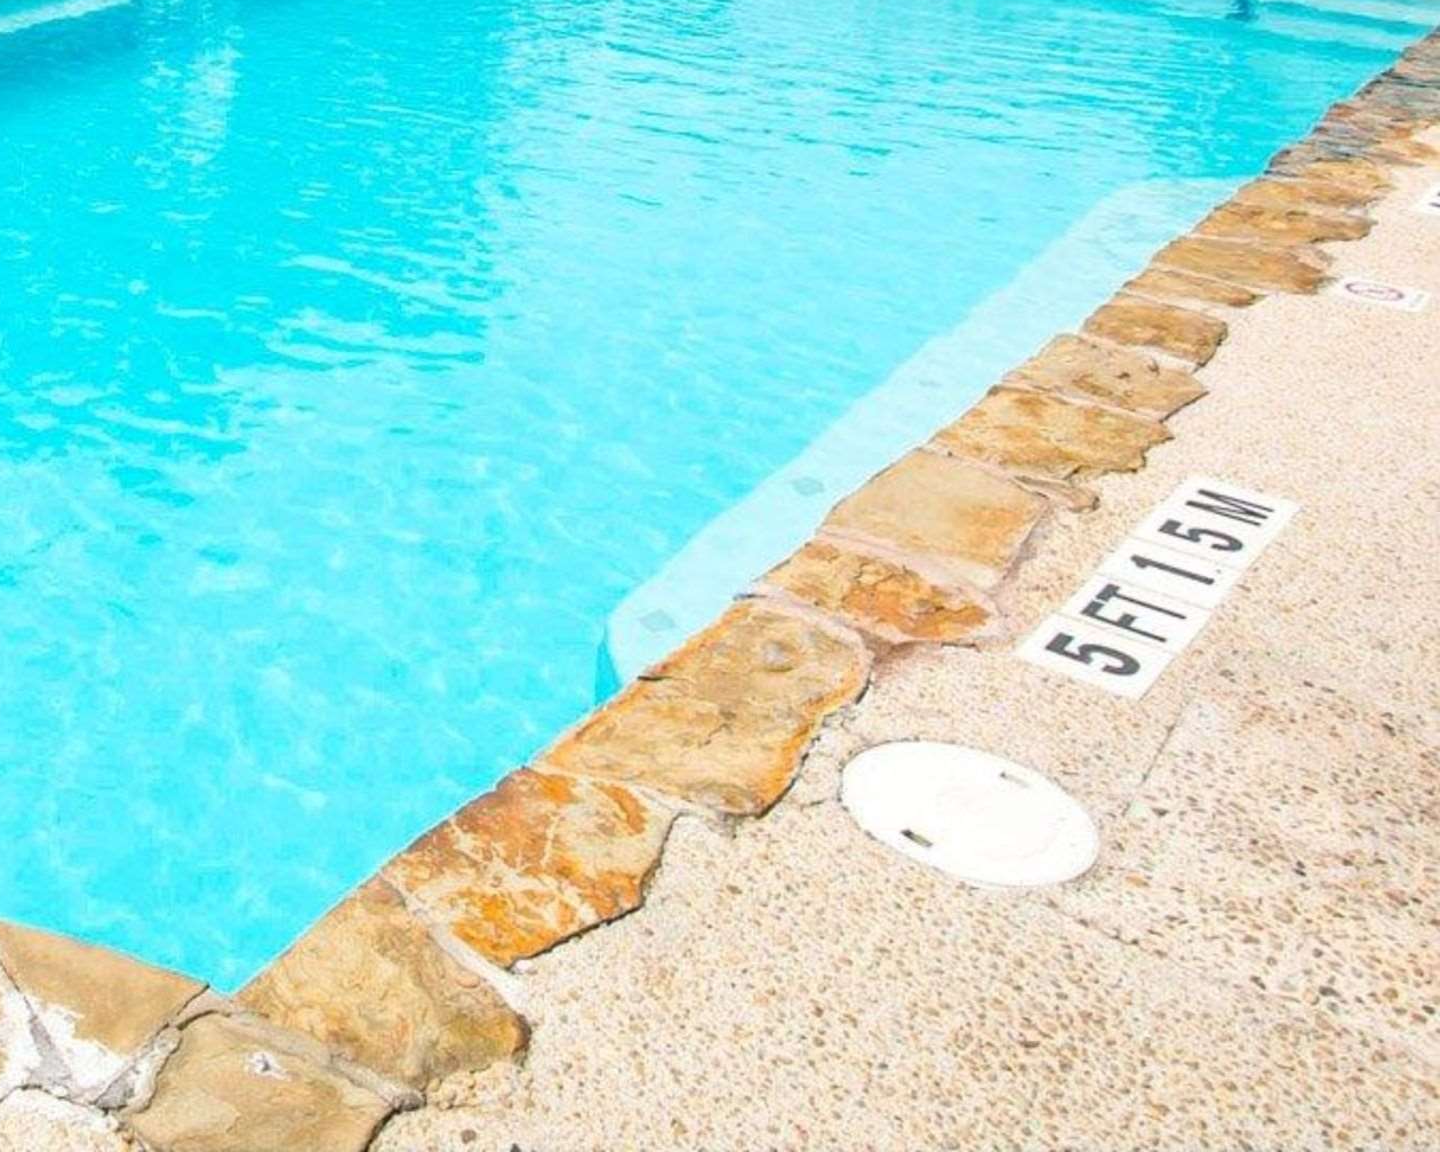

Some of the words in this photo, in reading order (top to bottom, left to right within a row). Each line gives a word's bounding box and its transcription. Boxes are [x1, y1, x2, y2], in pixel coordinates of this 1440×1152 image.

[1185, 488, 1275, 527] M
[1080, 583, 1187, 644] FT
[1044, 632, 1141, 677] 5
